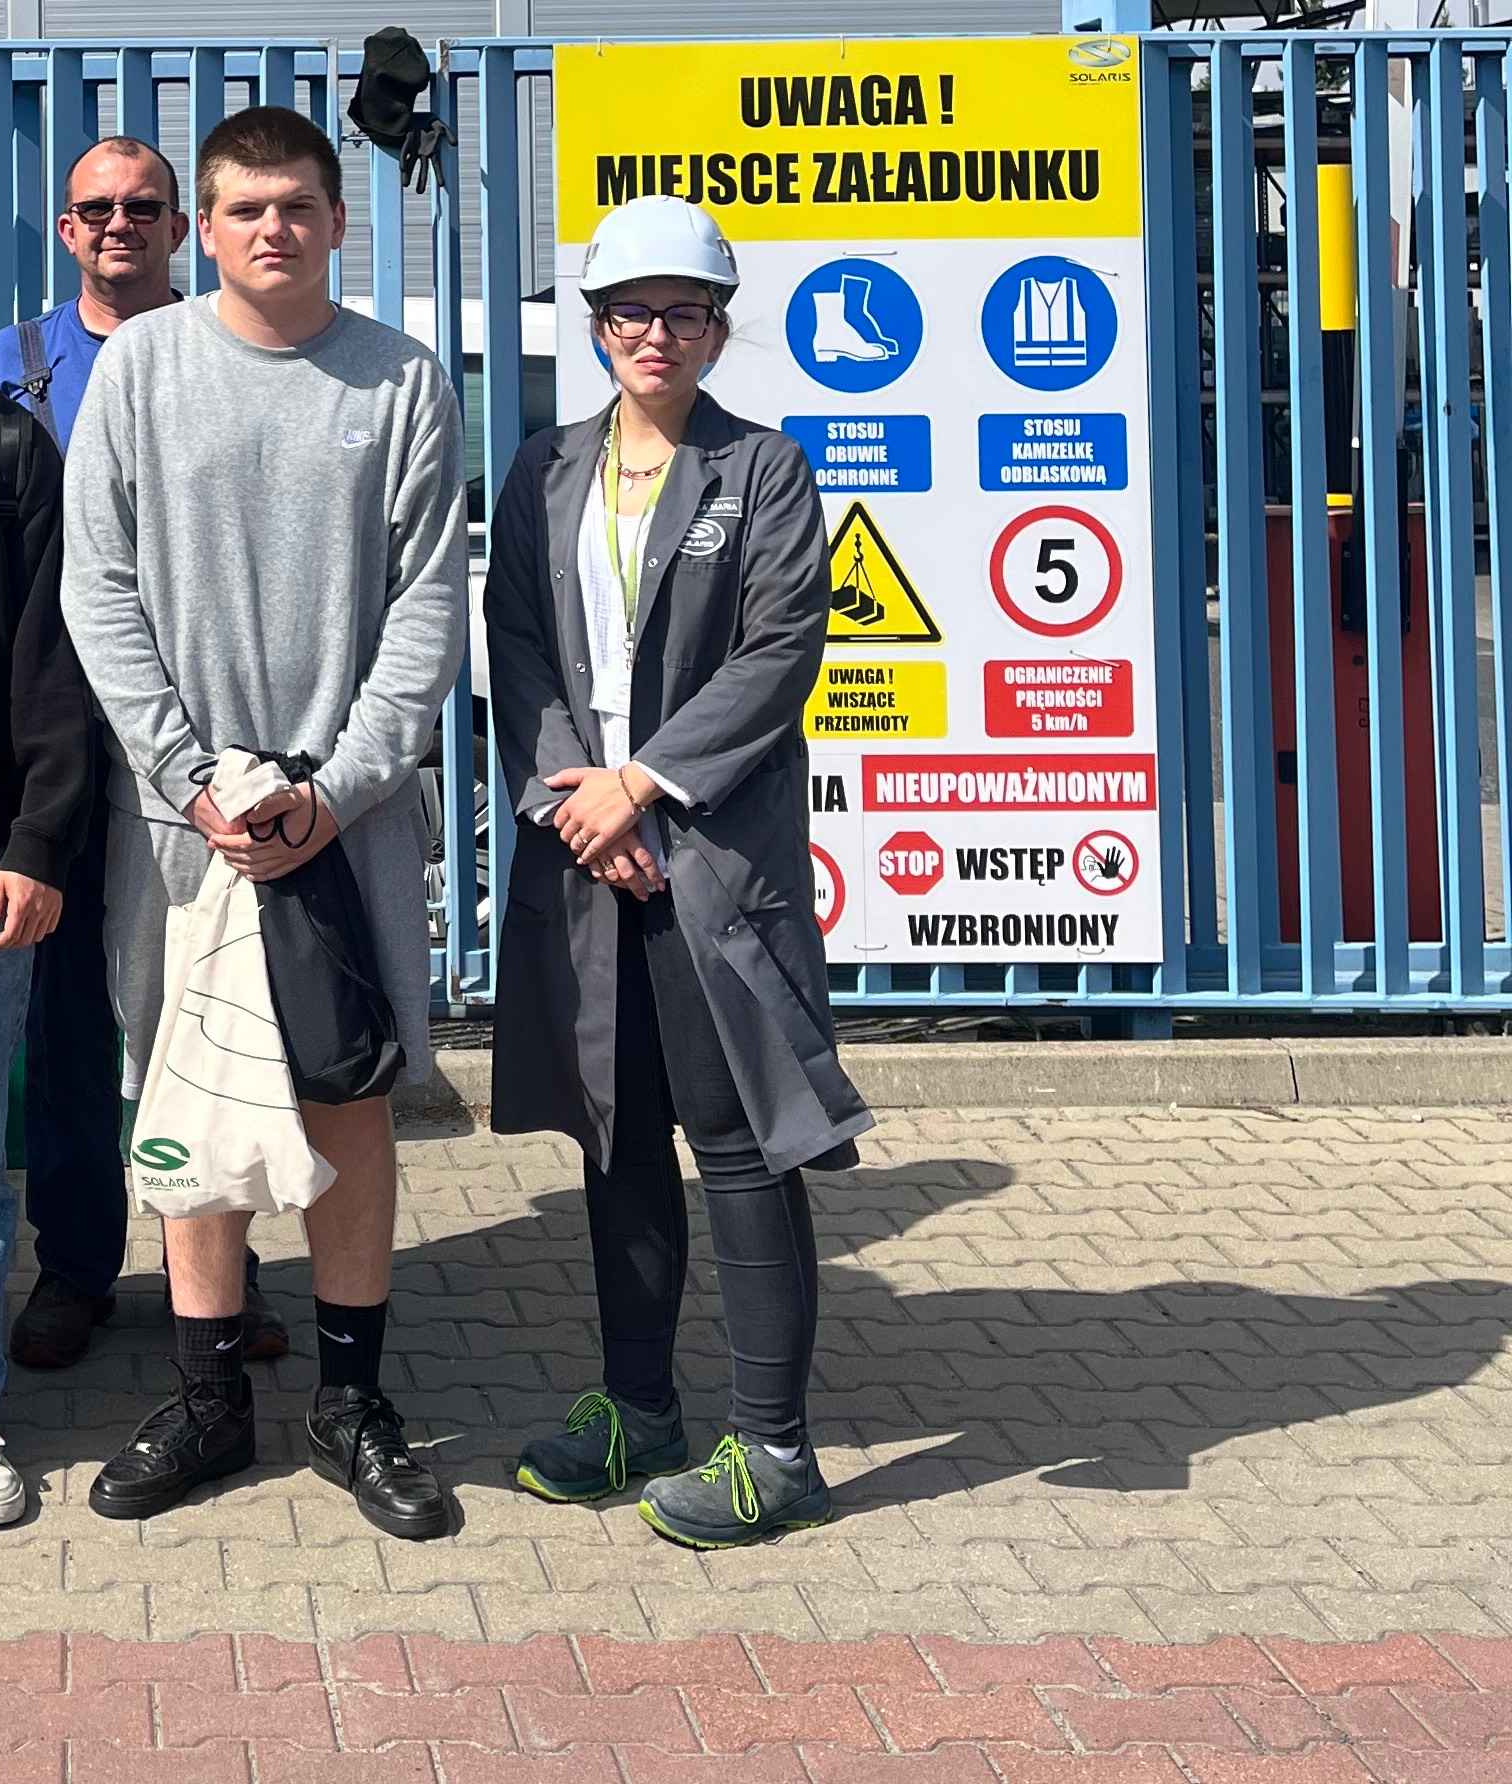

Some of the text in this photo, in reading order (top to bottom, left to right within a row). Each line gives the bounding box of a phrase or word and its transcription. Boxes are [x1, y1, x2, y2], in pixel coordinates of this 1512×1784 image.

[1069, 73, 1131, 82] SOLARIS
[740, 74, 954, 128] UWAGA !
[596, 149, 1100, 206] MIEJSCE ZAŁADUNKU
[827, 422, 884, 440] STOSUJ
[1023, 418, 1081, 437] STOSUJ
[825, 445, 888, 463] OBUWIE
[1012, 442, 1094, 462] KAMIZELKĘ
[816, 468, 898, 486] OCHRONNE
[1000, 466, 1107, 485] ODBLASKOWĄ
[1034, 538, 1079, 604] 5
[828, 668, 894, 685] UWAGA !
[1004, 667, 1113, 685] OGRANICZENIE
[827, 691, 896, 710] WISZĄCE
[1015, 687, 1103, 711] PRĘDKOŚCI
[814, 715, 909, 732] PRZEDMIOTY
[1031, 713, 1088, 732] 5 km/h
[812, 775, 849, 813] IA
[875, 766, 1147, 804] NIEUPOWAŻNIONYM
[879, 847, 1065, 887] STOP WSTĘP
[907, 913, 1119, 946] WZBRONIONY
[141, 1176, 200, 1188] SOLARIS
